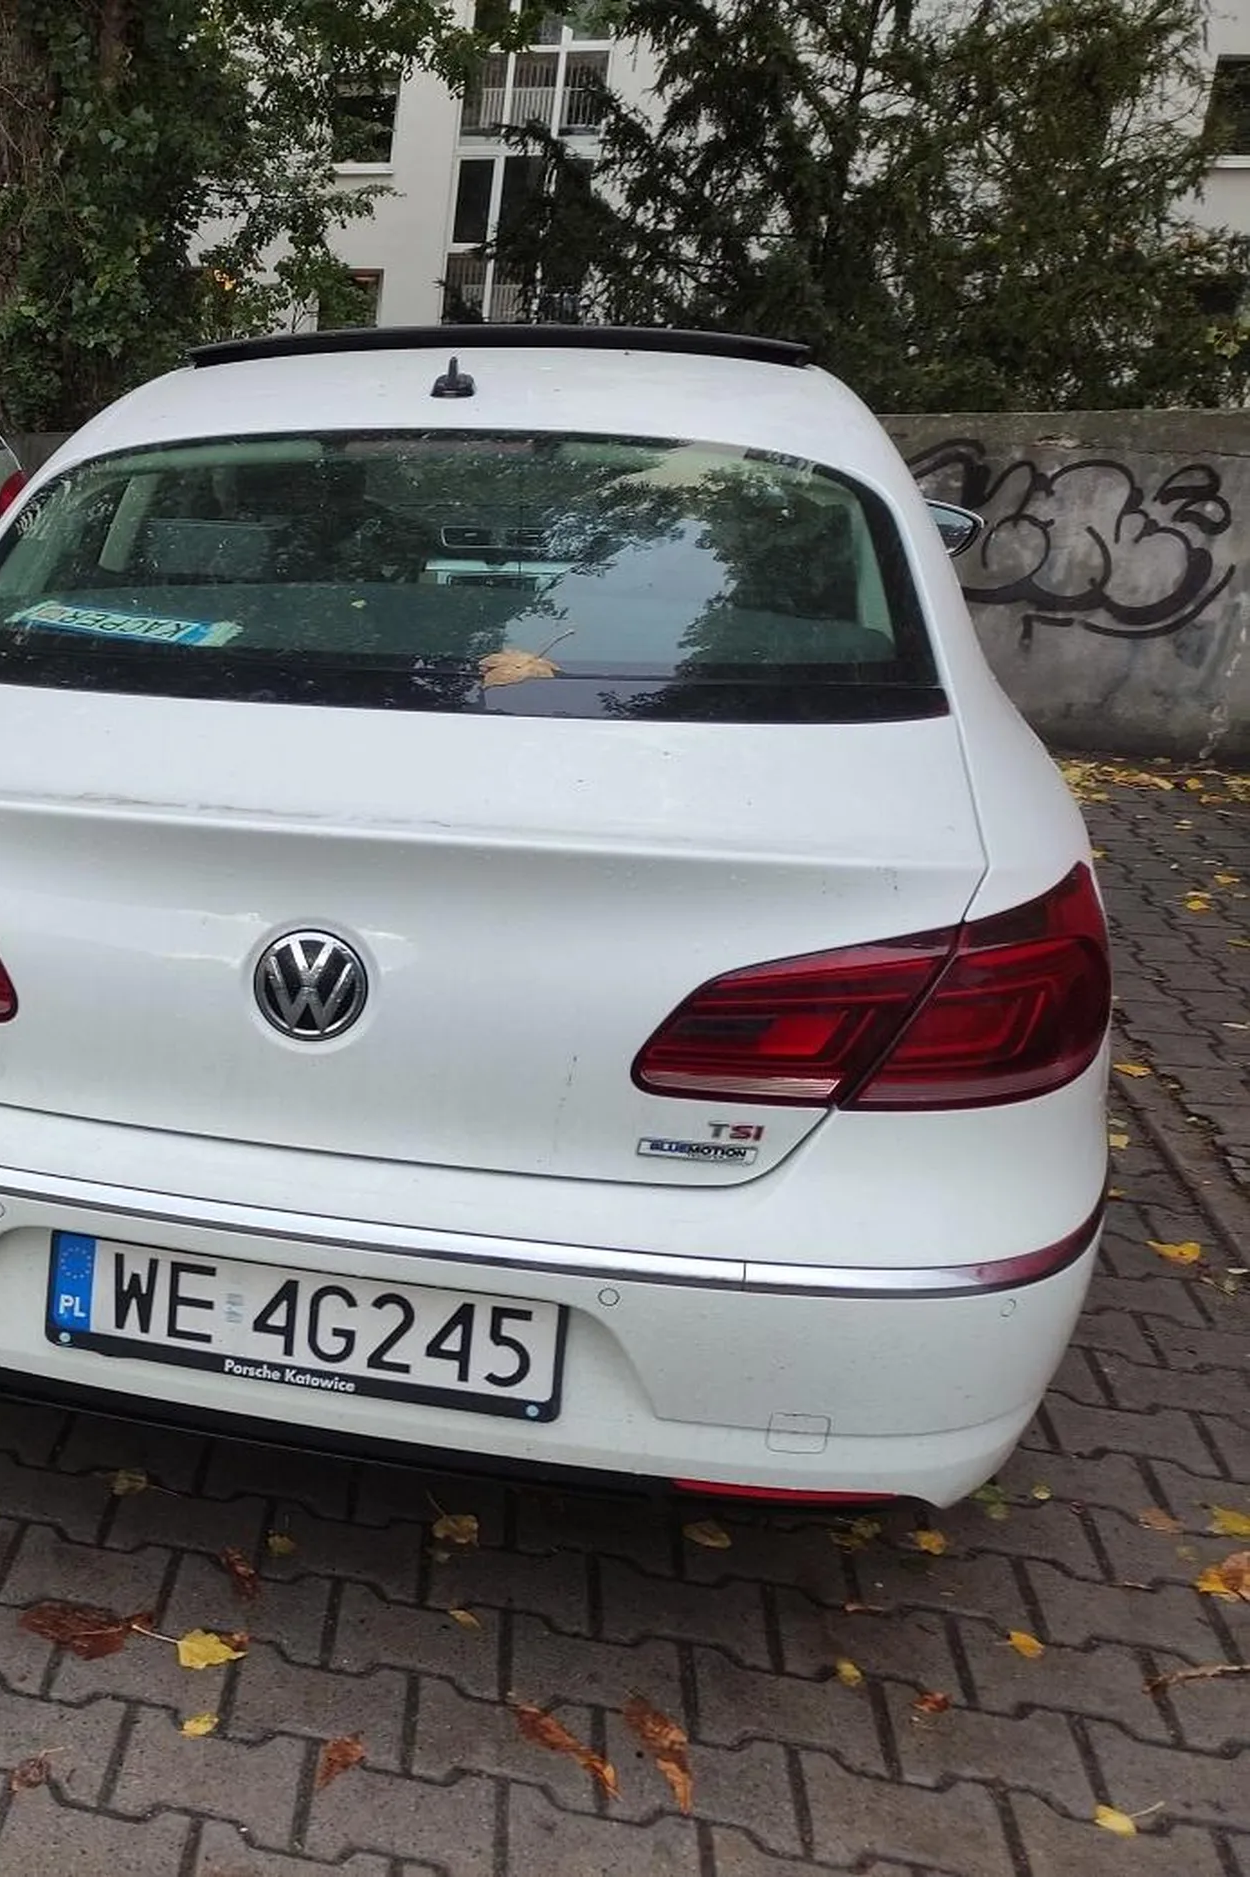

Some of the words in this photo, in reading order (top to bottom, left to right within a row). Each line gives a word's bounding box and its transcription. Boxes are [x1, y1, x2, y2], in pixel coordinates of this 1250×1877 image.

[62, 610, 192, 638] KACPER
[708, 1120, 765, 1141] TSI
[59, 1294, 86, 1318] PL
[114, 1252, 217, 1344] WE
[252, 1279, 533, 1387] 4G245
[224, 1358, 281, 1381] Porsche
[283, 1368, 356, 1393] Katowice
